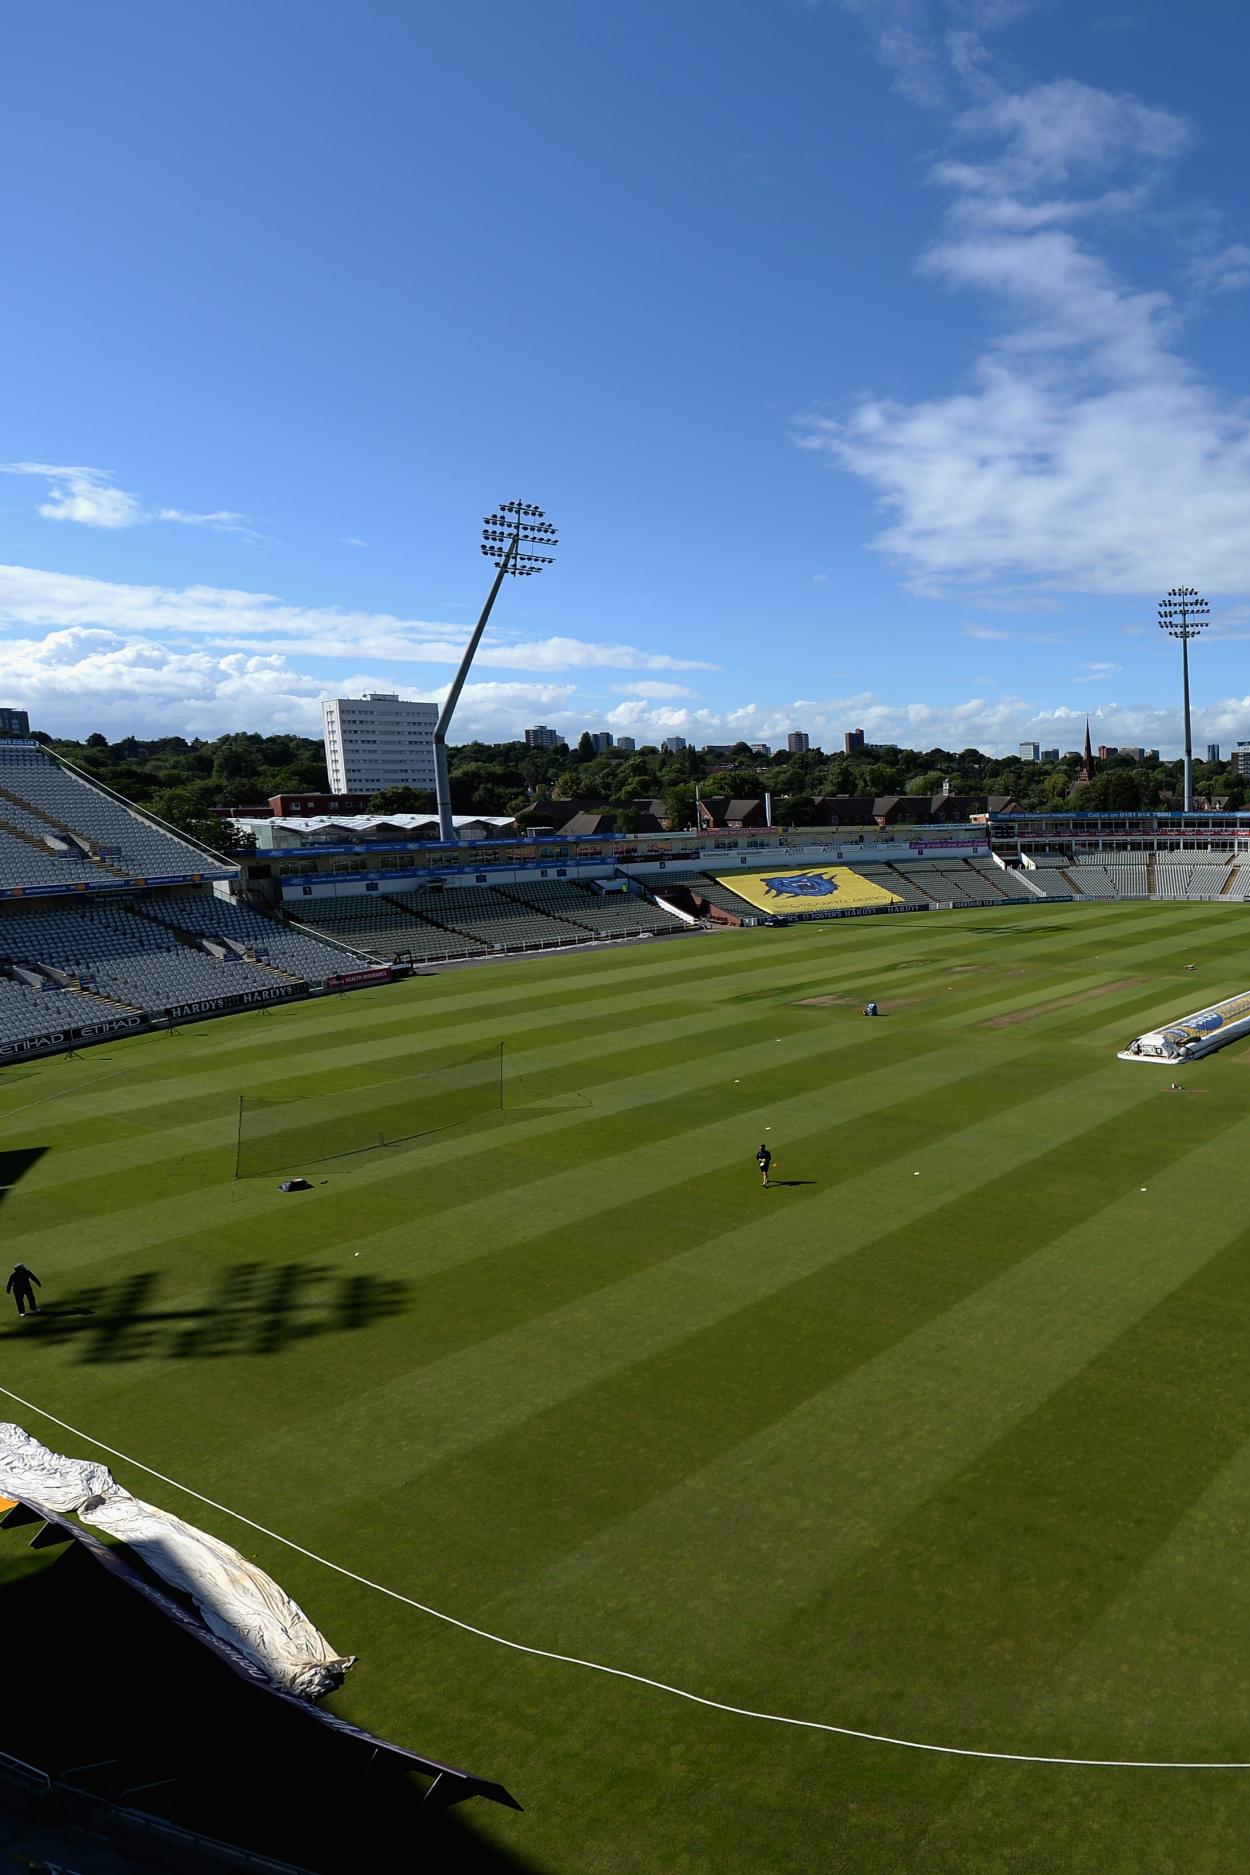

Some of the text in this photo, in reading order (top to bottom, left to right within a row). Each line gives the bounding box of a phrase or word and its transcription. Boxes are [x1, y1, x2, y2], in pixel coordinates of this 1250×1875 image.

[243, 985, 294, 1004] HARDYS
[172, 998, 224, 1018] HARDYS
[81, 1018, 140, 1036] ETIHAD
[0, 1034, 64, 1055] ETIHAD
